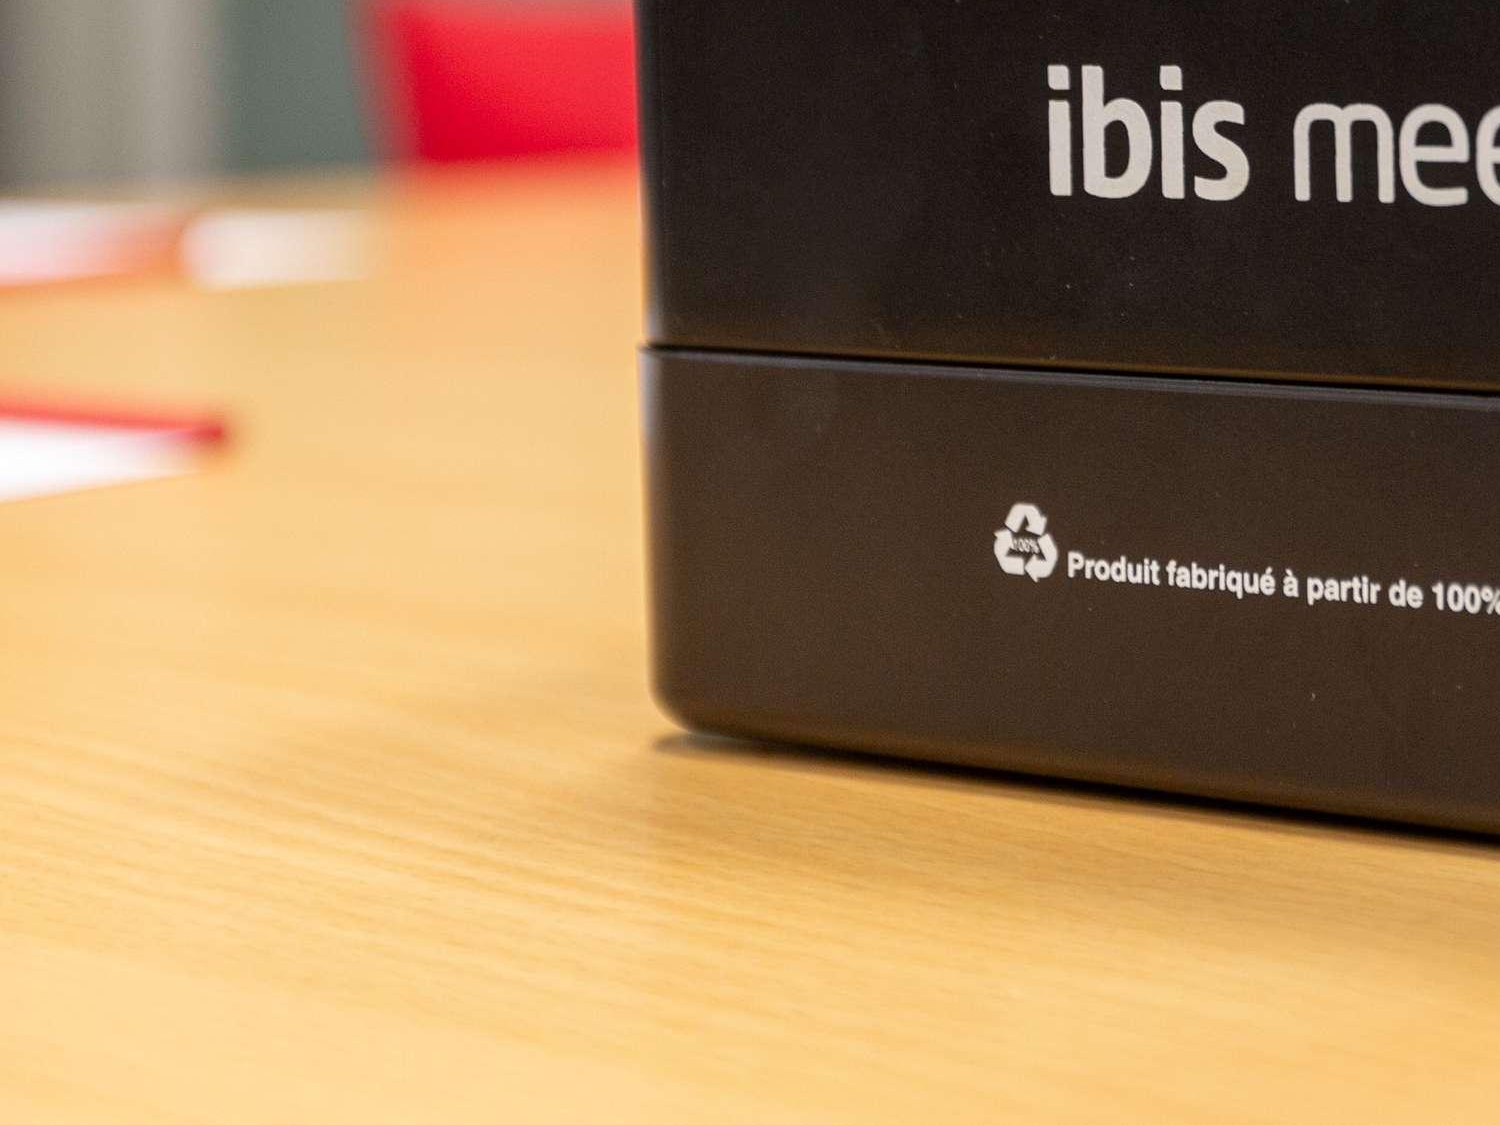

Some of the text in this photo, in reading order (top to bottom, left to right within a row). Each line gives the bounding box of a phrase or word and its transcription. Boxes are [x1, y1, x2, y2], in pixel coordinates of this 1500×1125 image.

[1047, 64, 1250, 201] ibis
[1067, 550, 1161, 586] Produit
[1165, 559, 1276, 600] fabriqué
[1282, 568, 1300, 598] à
[1306, 575, 1382, 606] partir
[1388, 578, 1424, 609] de
